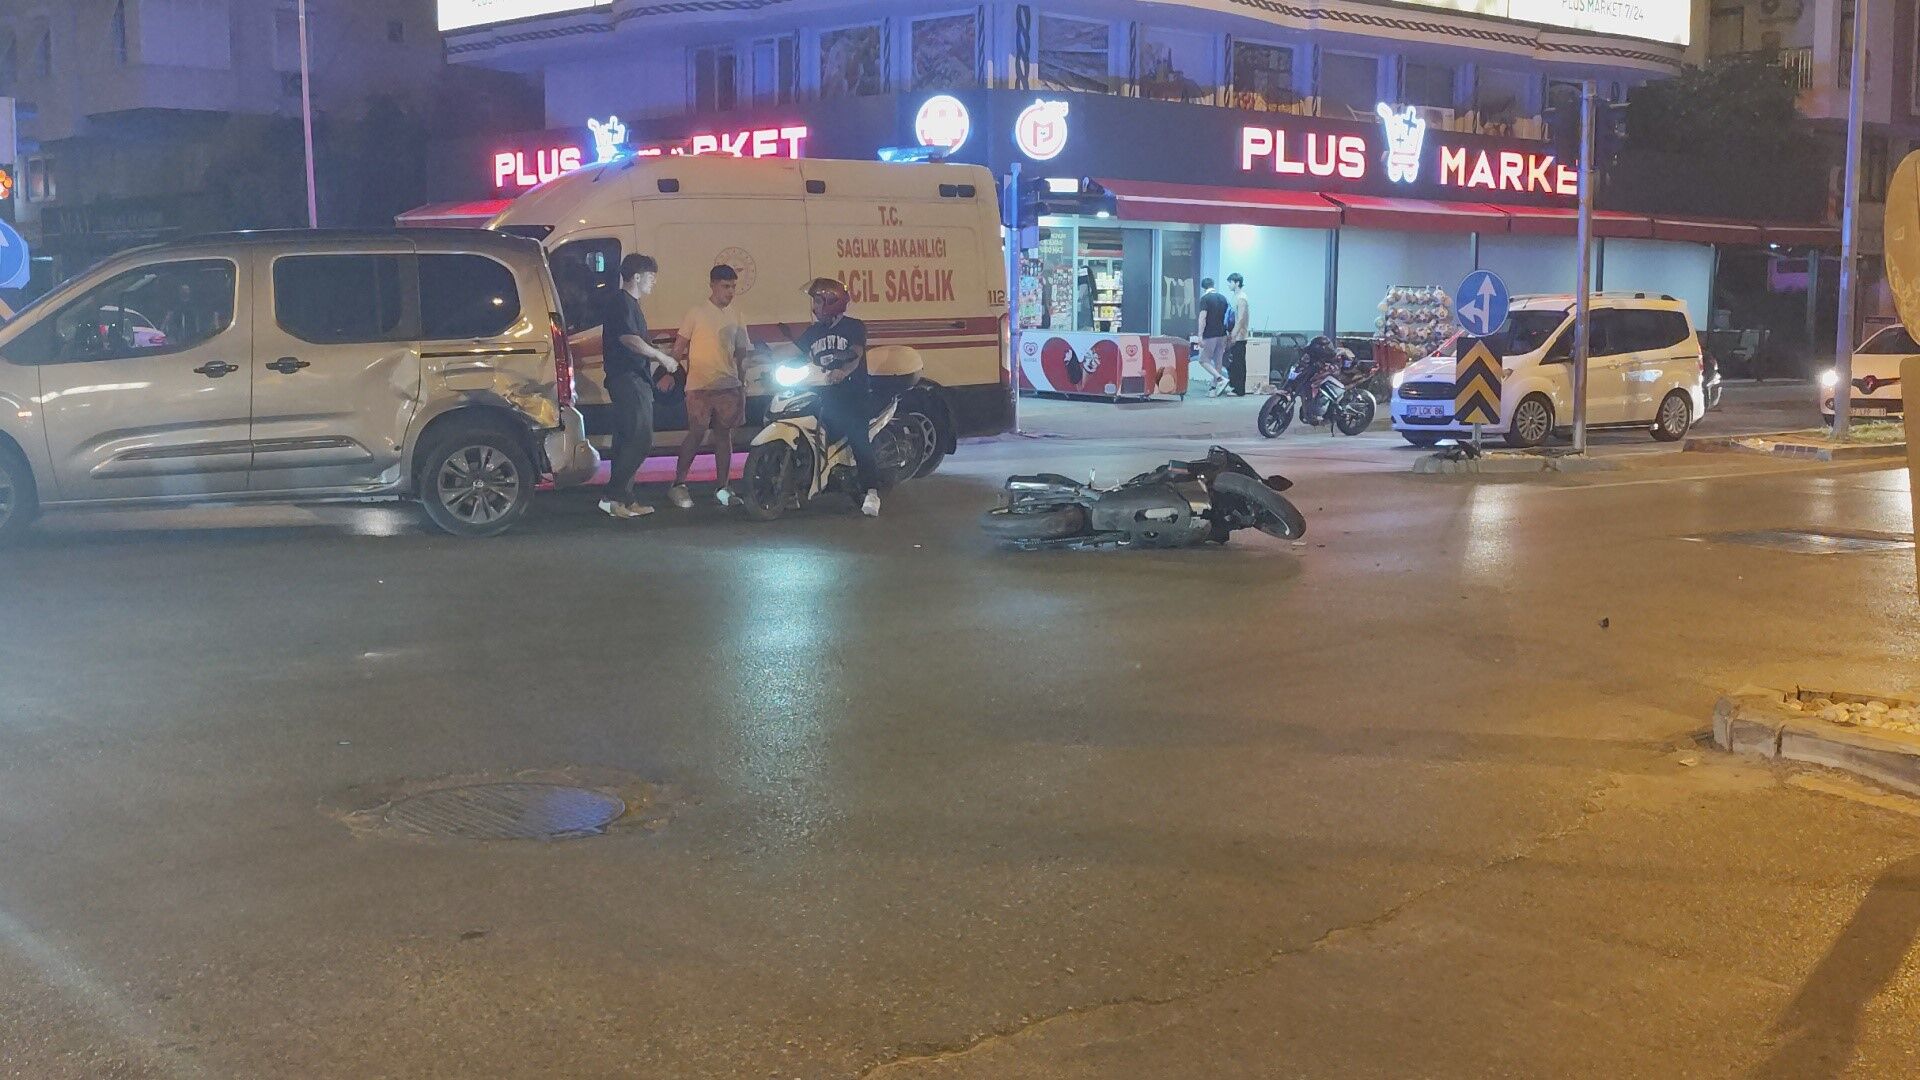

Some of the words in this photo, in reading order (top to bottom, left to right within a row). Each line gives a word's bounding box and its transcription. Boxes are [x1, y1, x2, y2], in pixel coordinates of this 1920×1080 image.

[1587, 0, 1622, 17] MARKET
[1625, 4, 1644, 20] 7/24
[495, 147, 581, 187] PLUS
[1242, 127, 1366, 178] PLUS
[1440, 146, 1579, 195] MARKE
[878, 205, 903, 226] T.C.
[885, 264, 955, 302] SAĞLIK
[988, 289, 1005, 304] 112
